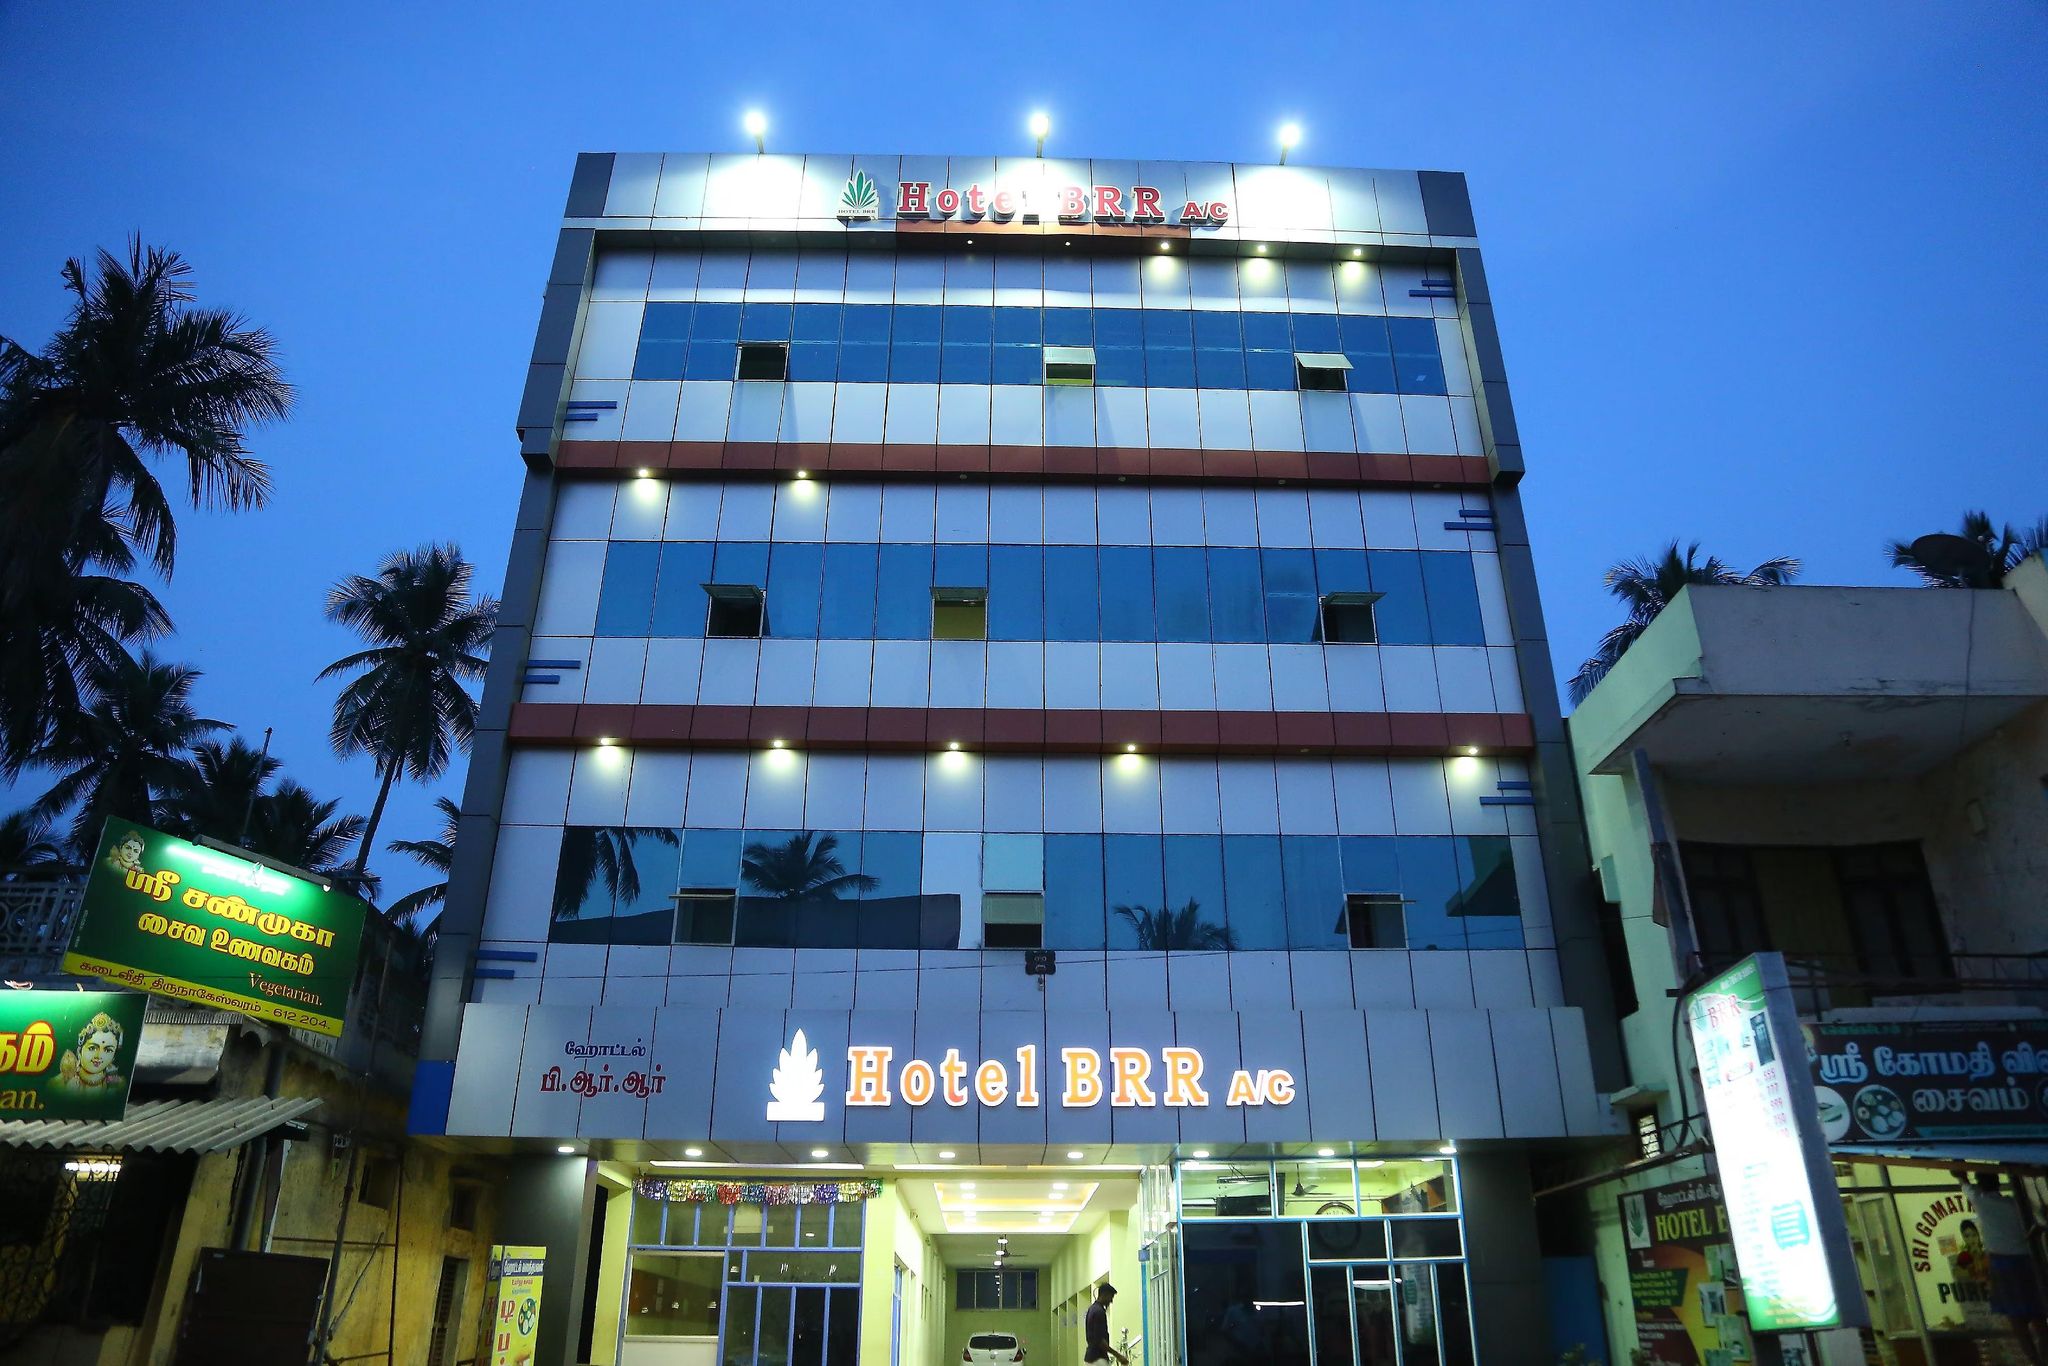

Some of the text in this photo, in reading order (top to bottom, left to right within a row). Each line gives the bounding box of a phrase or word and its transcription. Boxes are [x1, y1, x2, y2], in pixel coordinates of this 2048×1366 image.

[897, 181, 1229, 219] Hote BRR A/C
[182, 887, 335, 948] சண்முகா
[138, 913, 207, 947] சைவ
[210, 928, 314, 976] உணவகம்
[249, 972, 323, 1006] Vegetarian.
[273, 1007, 297, 1021] 612
[299, 1015, 331, 1030] 204.
[564, 1038, 647, 1060] ஹோட்டல்
[1873, 1040, 1996, 1081] கோமதி
[845, 1044, 1296, 1108] Hotel BRR A/C
[1912, 1076, 2030, 1112] சைவம்
[1656, 1209, 1712, 1241] HOTEL
[1912, 1238, 1931, 1273] SRI
